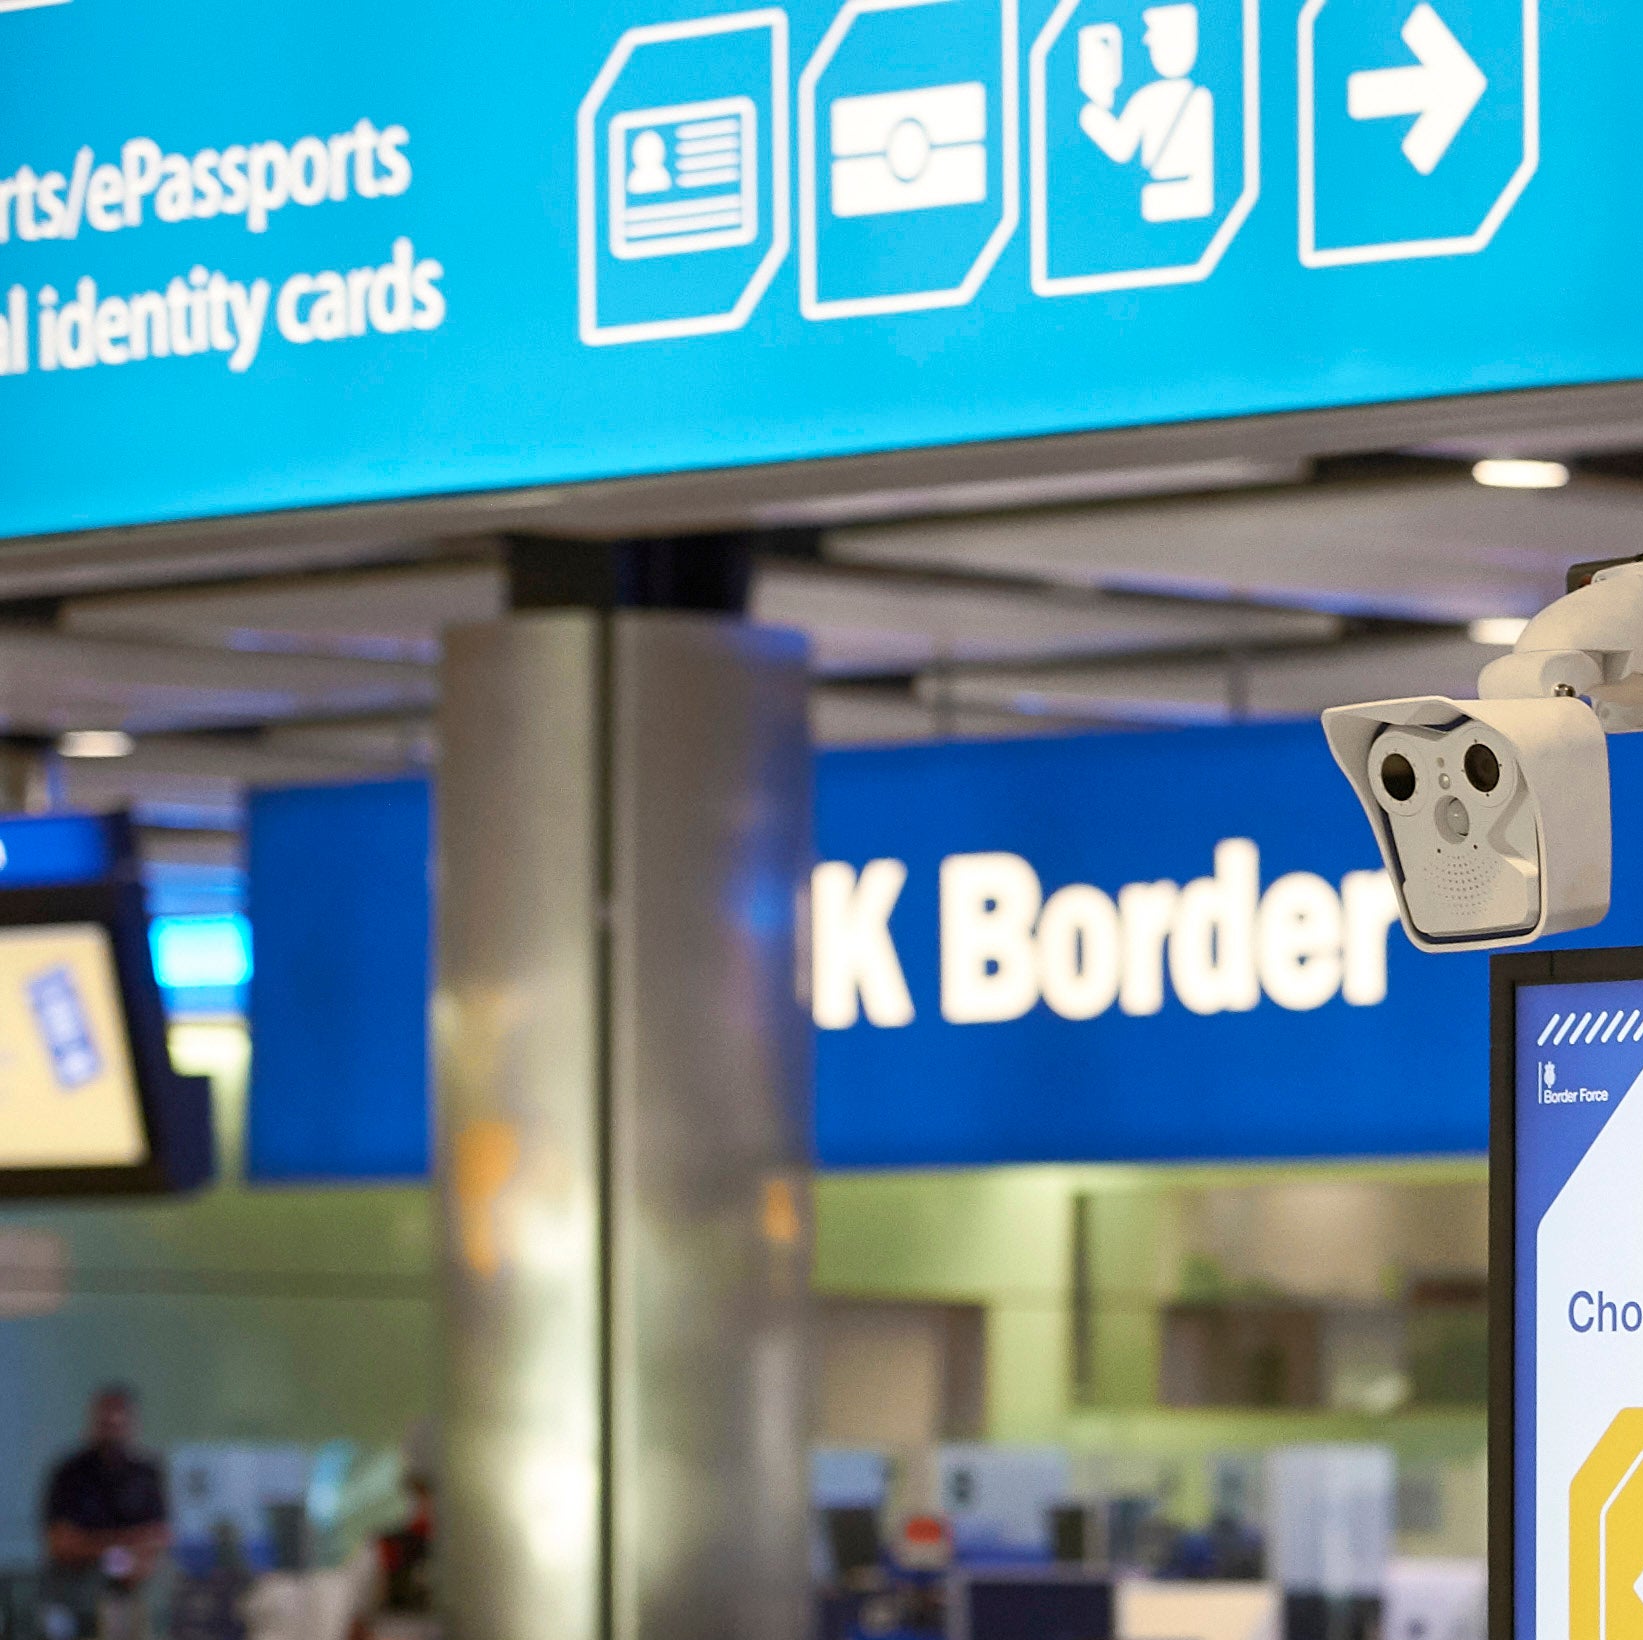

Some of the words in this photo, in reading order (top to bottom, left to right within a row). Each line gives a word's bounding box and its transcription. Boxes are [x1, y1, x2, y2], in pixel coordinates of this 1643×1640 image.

[0, 284, 28, 376] l
[38, 265, 271, 372] identity
[276, 236, 446, 343] cards
[939, 837, 1400, 1024] Border
[1544, 1089, 1578, 1104] Border
[1579, 1088, 1608, 1103] Force
